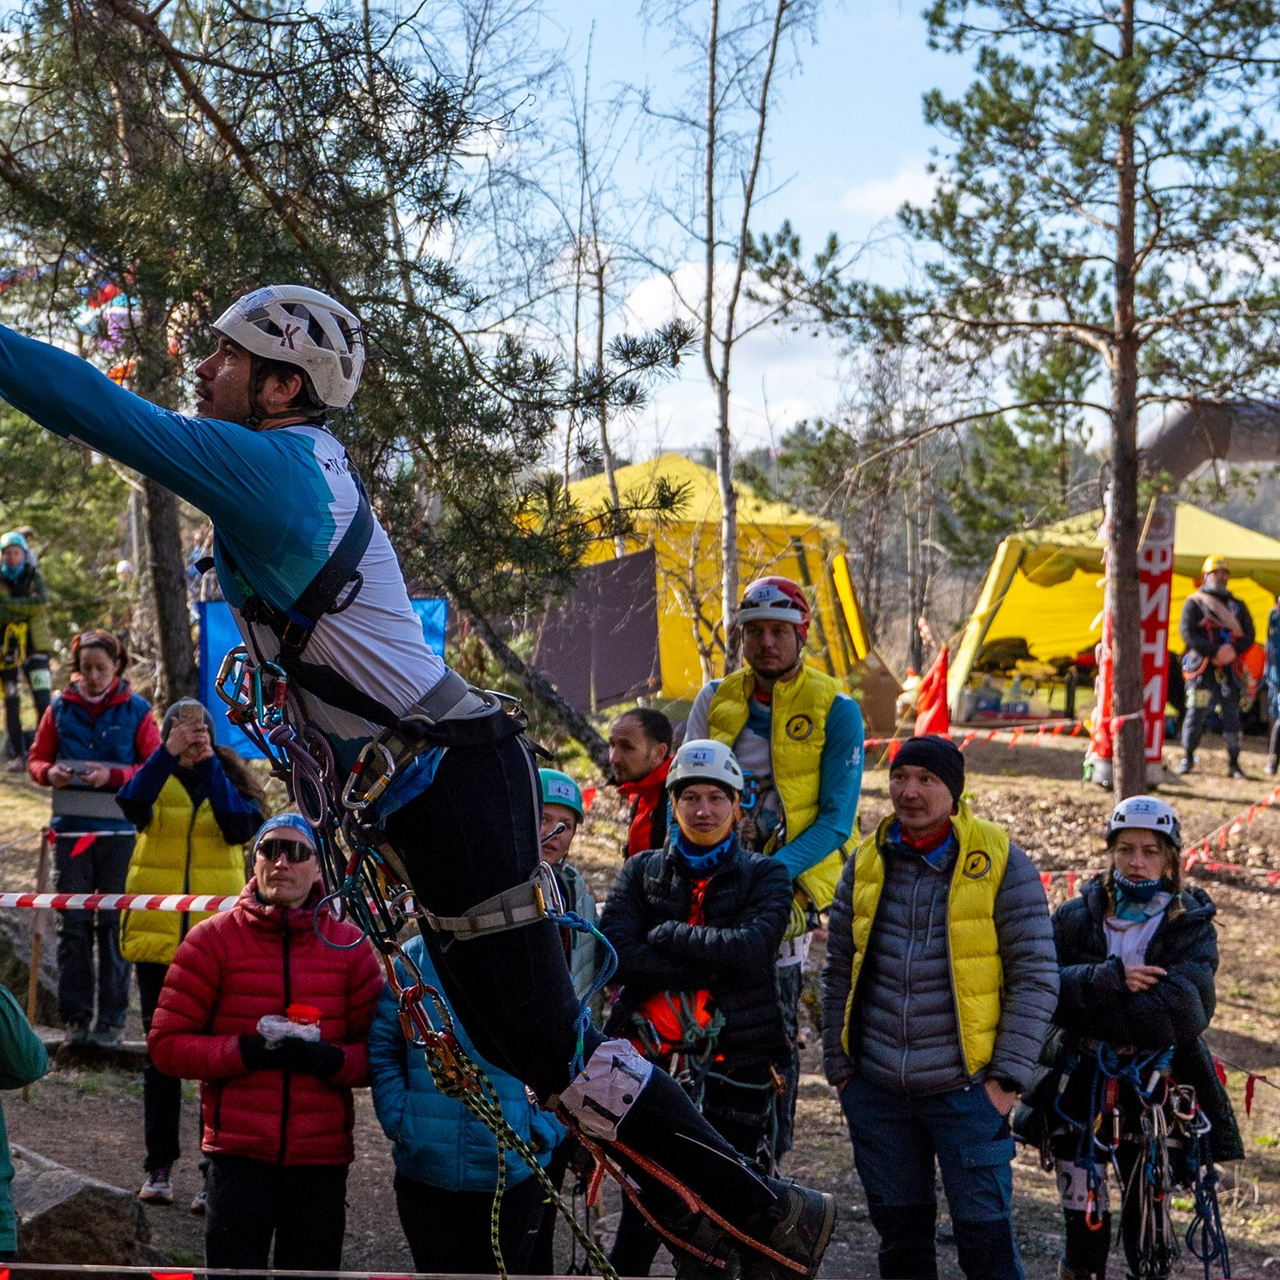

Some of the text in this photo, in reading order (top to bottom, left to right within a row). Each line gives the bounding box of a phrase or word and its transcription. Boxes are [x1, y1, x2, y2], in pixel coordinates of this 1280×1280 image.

[692, 752, 706, 760] 4.1
[556, 787, 569, 796] 4.2
[1135, 803, 1150, 811] 2.2
[581, 1054, 647, 1131] 1.1
[1059, 1171, 1088, 1201] 2.
